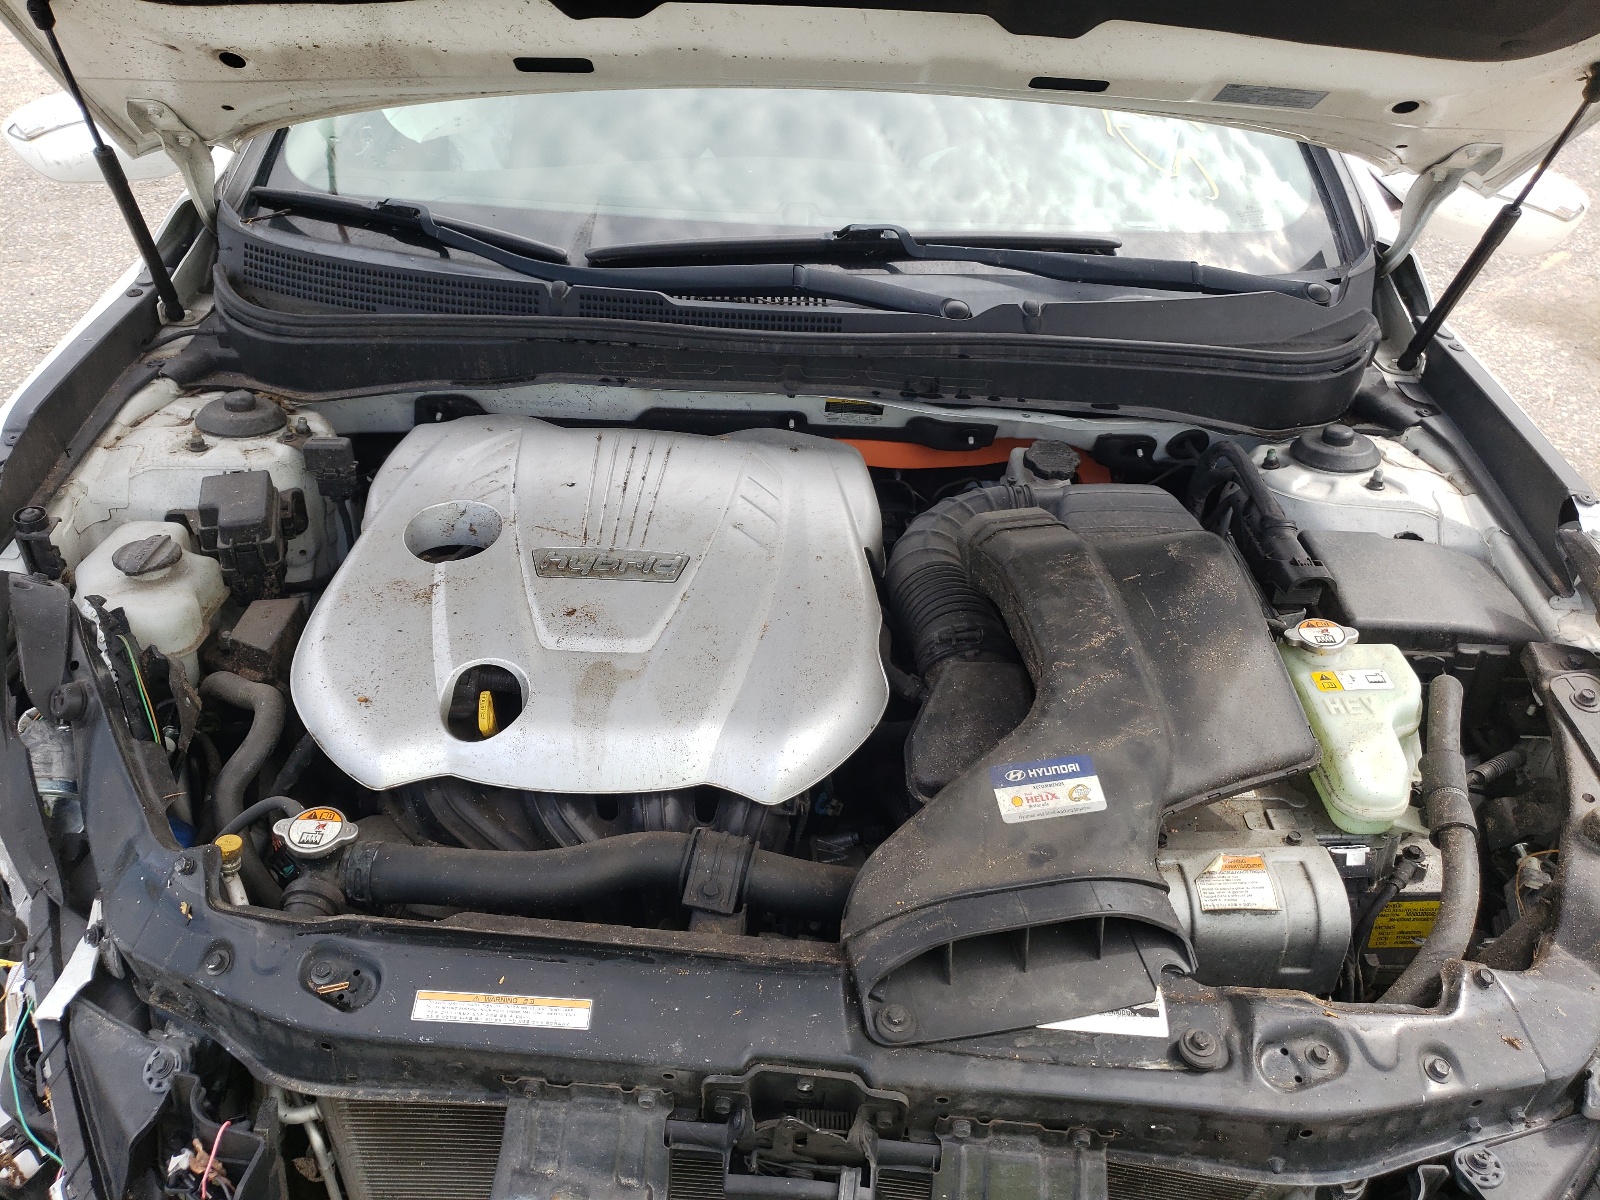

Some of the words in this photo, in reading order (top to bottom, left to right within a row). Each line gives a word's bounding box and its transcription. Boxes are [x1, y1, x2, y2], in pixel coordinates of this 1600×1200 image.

[1028, 763, 1080, 778] HYUNDAI
[1025, 791, 1060, 804] HELIX
[484, 996, 518, 1004] WARNING
